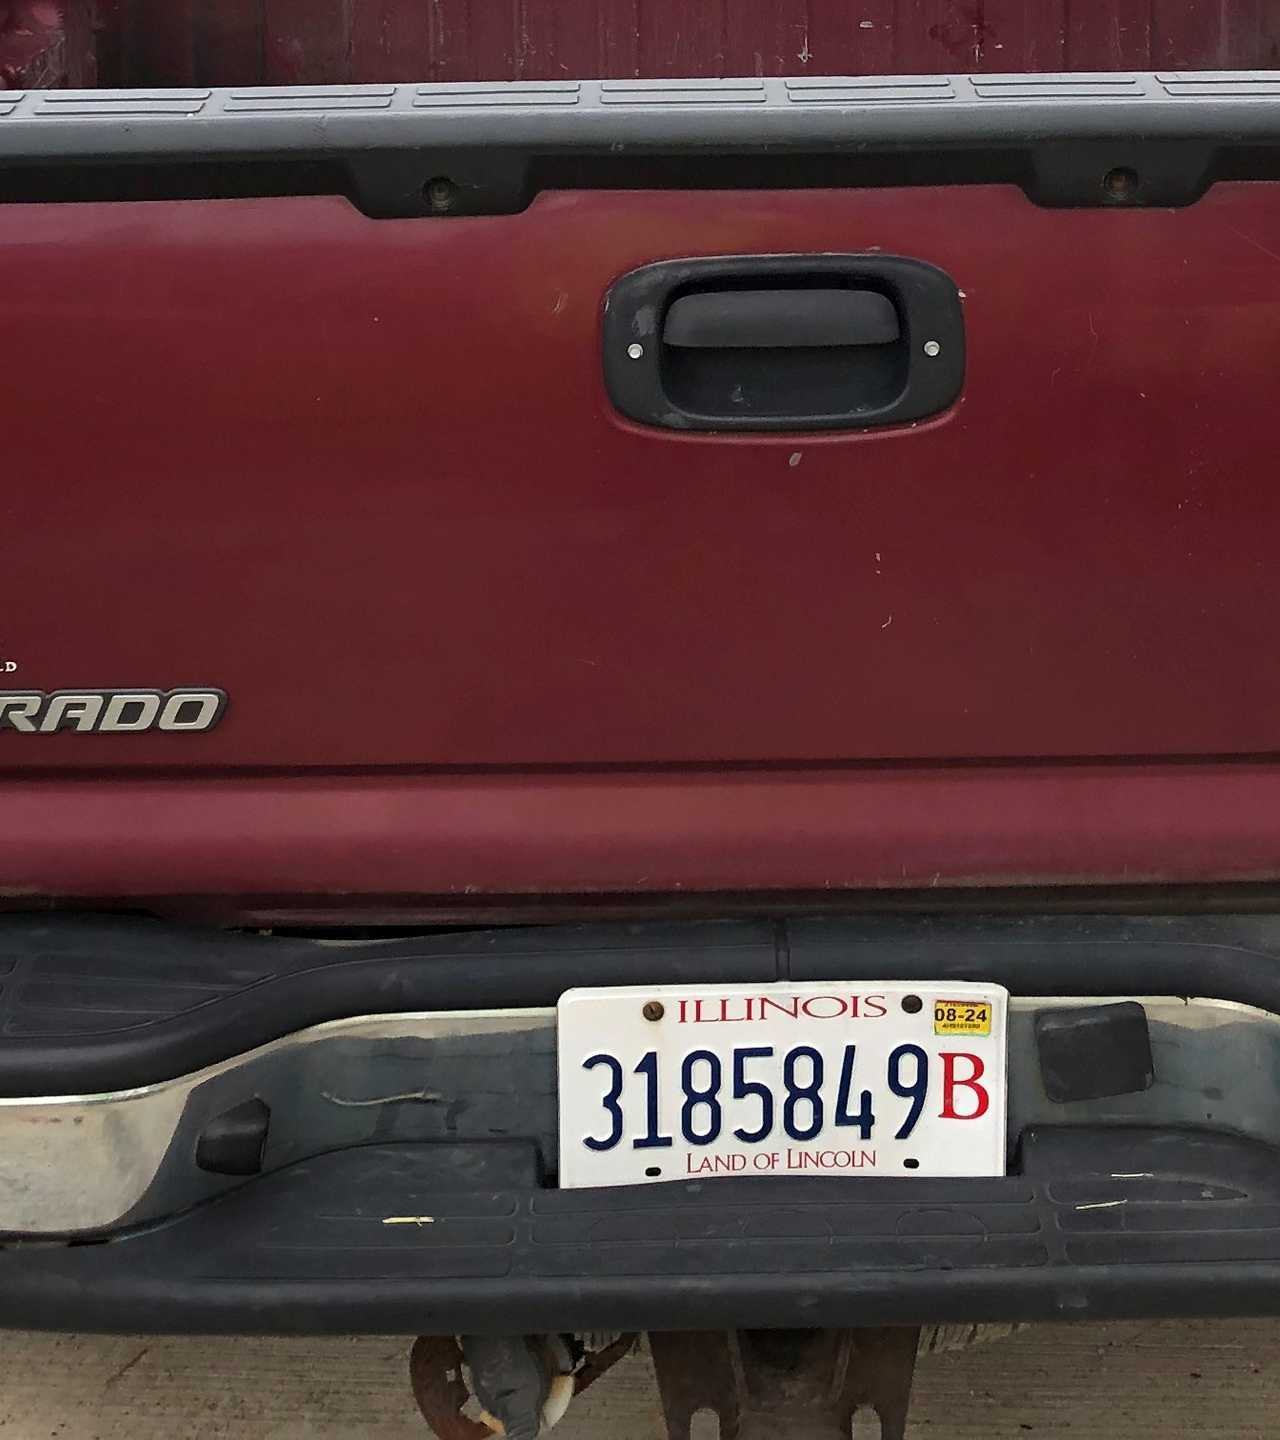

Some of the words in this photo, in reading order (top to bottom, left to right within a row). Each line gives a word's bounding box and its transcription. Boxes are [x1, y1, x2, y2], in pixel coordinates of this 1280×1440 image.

[678, 995, 888, 1024] ILLINOIS
[934, 1008, 987, 1022] 08-24
[581, 1043, 929, 1152] 3185849
[937, 1052, 990, 1120] B
[686, 1151, 747, 1175] LAND
[754, 1153, 780, 1171] OF
[787, 1148, 877, 1170] LINCOLN
